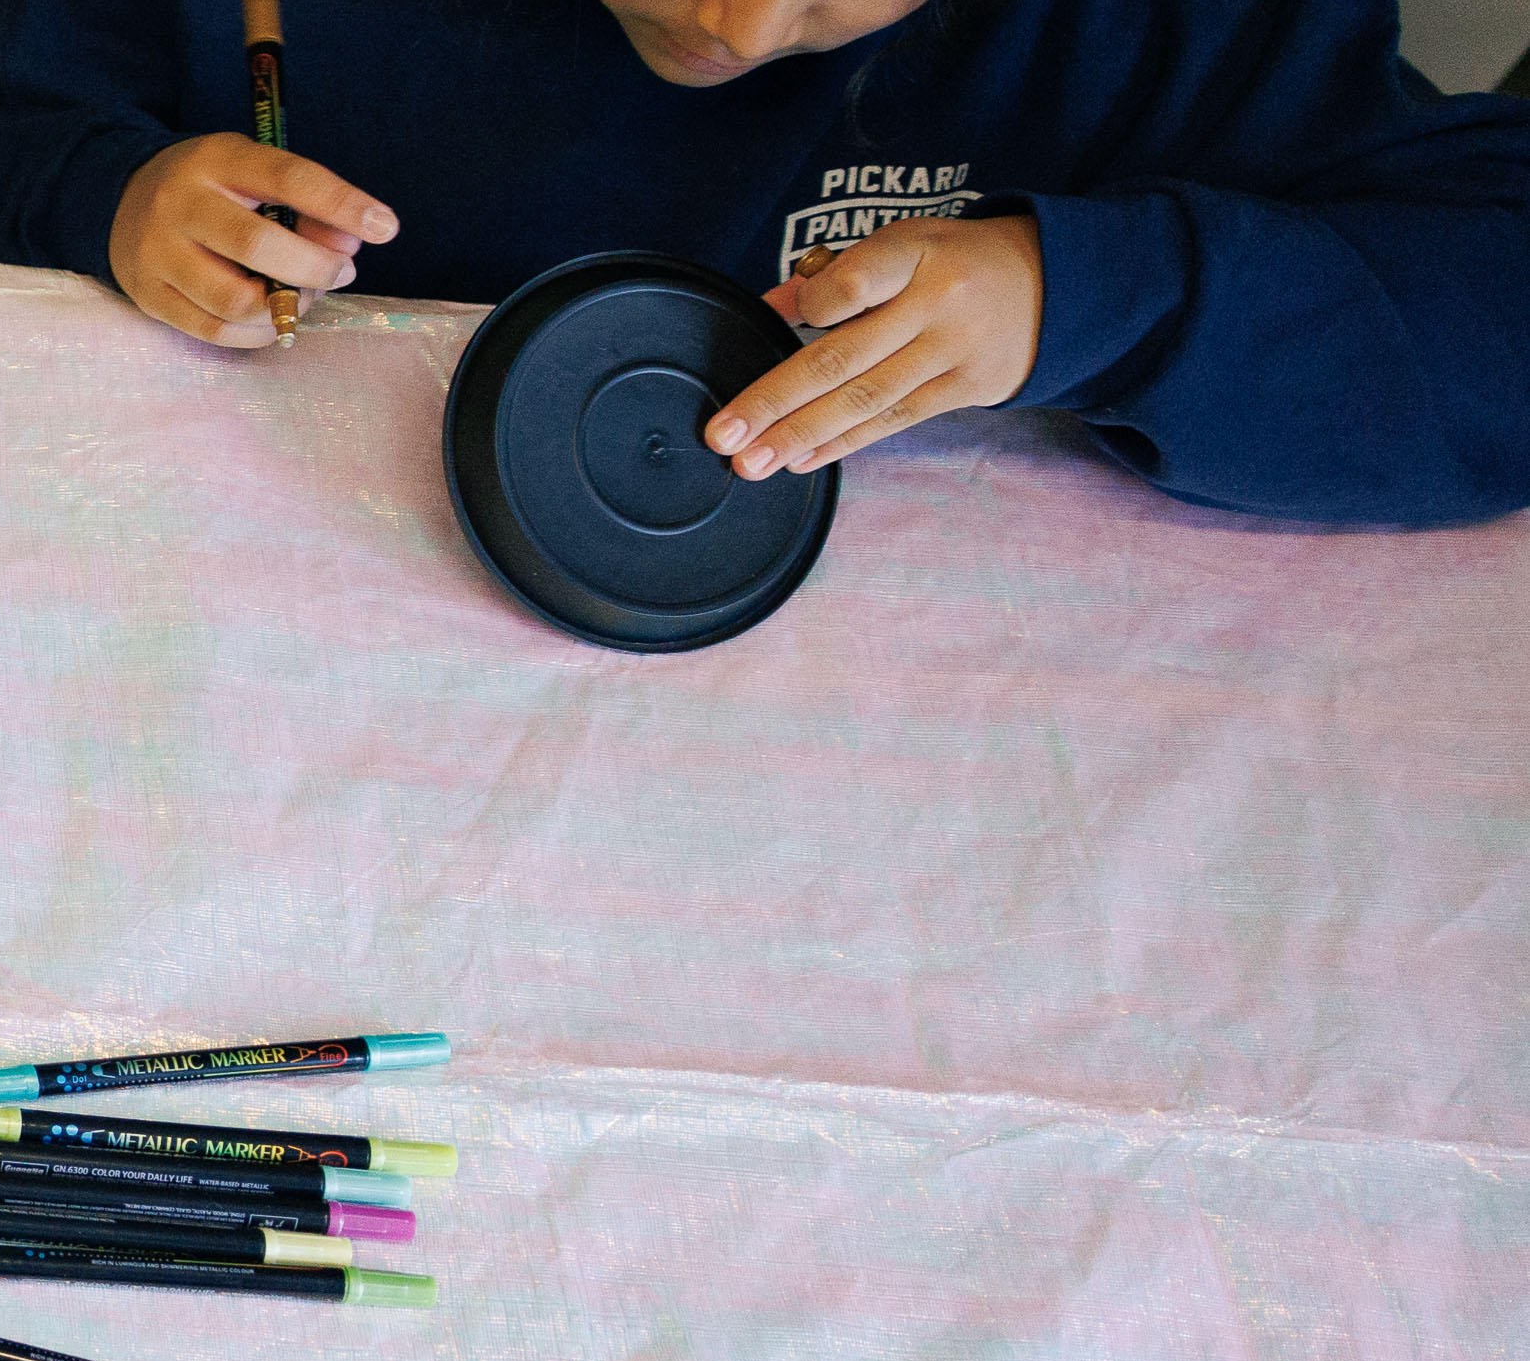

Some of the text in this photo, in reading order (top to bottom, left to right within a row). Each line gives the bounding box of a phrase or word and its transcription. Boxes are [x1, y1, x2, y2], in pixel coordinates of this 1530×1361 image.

[821, 163, 970, 198] PICKARD
[116, 1053, 205, 1077] METALLIC
[209, 1047, 286, 1067] MARKER
[107, 1131, 285, 1162] METALLIC MARKER
[52, 1164, 88, 1174] GN.6300
[91, 1167, 120, 1177] COLOR
[122, 1170, 146, 1179] YOUR
[147, 1172, 175, 1181] DALLY
[175, 1175, 193, 1183] LIFE
